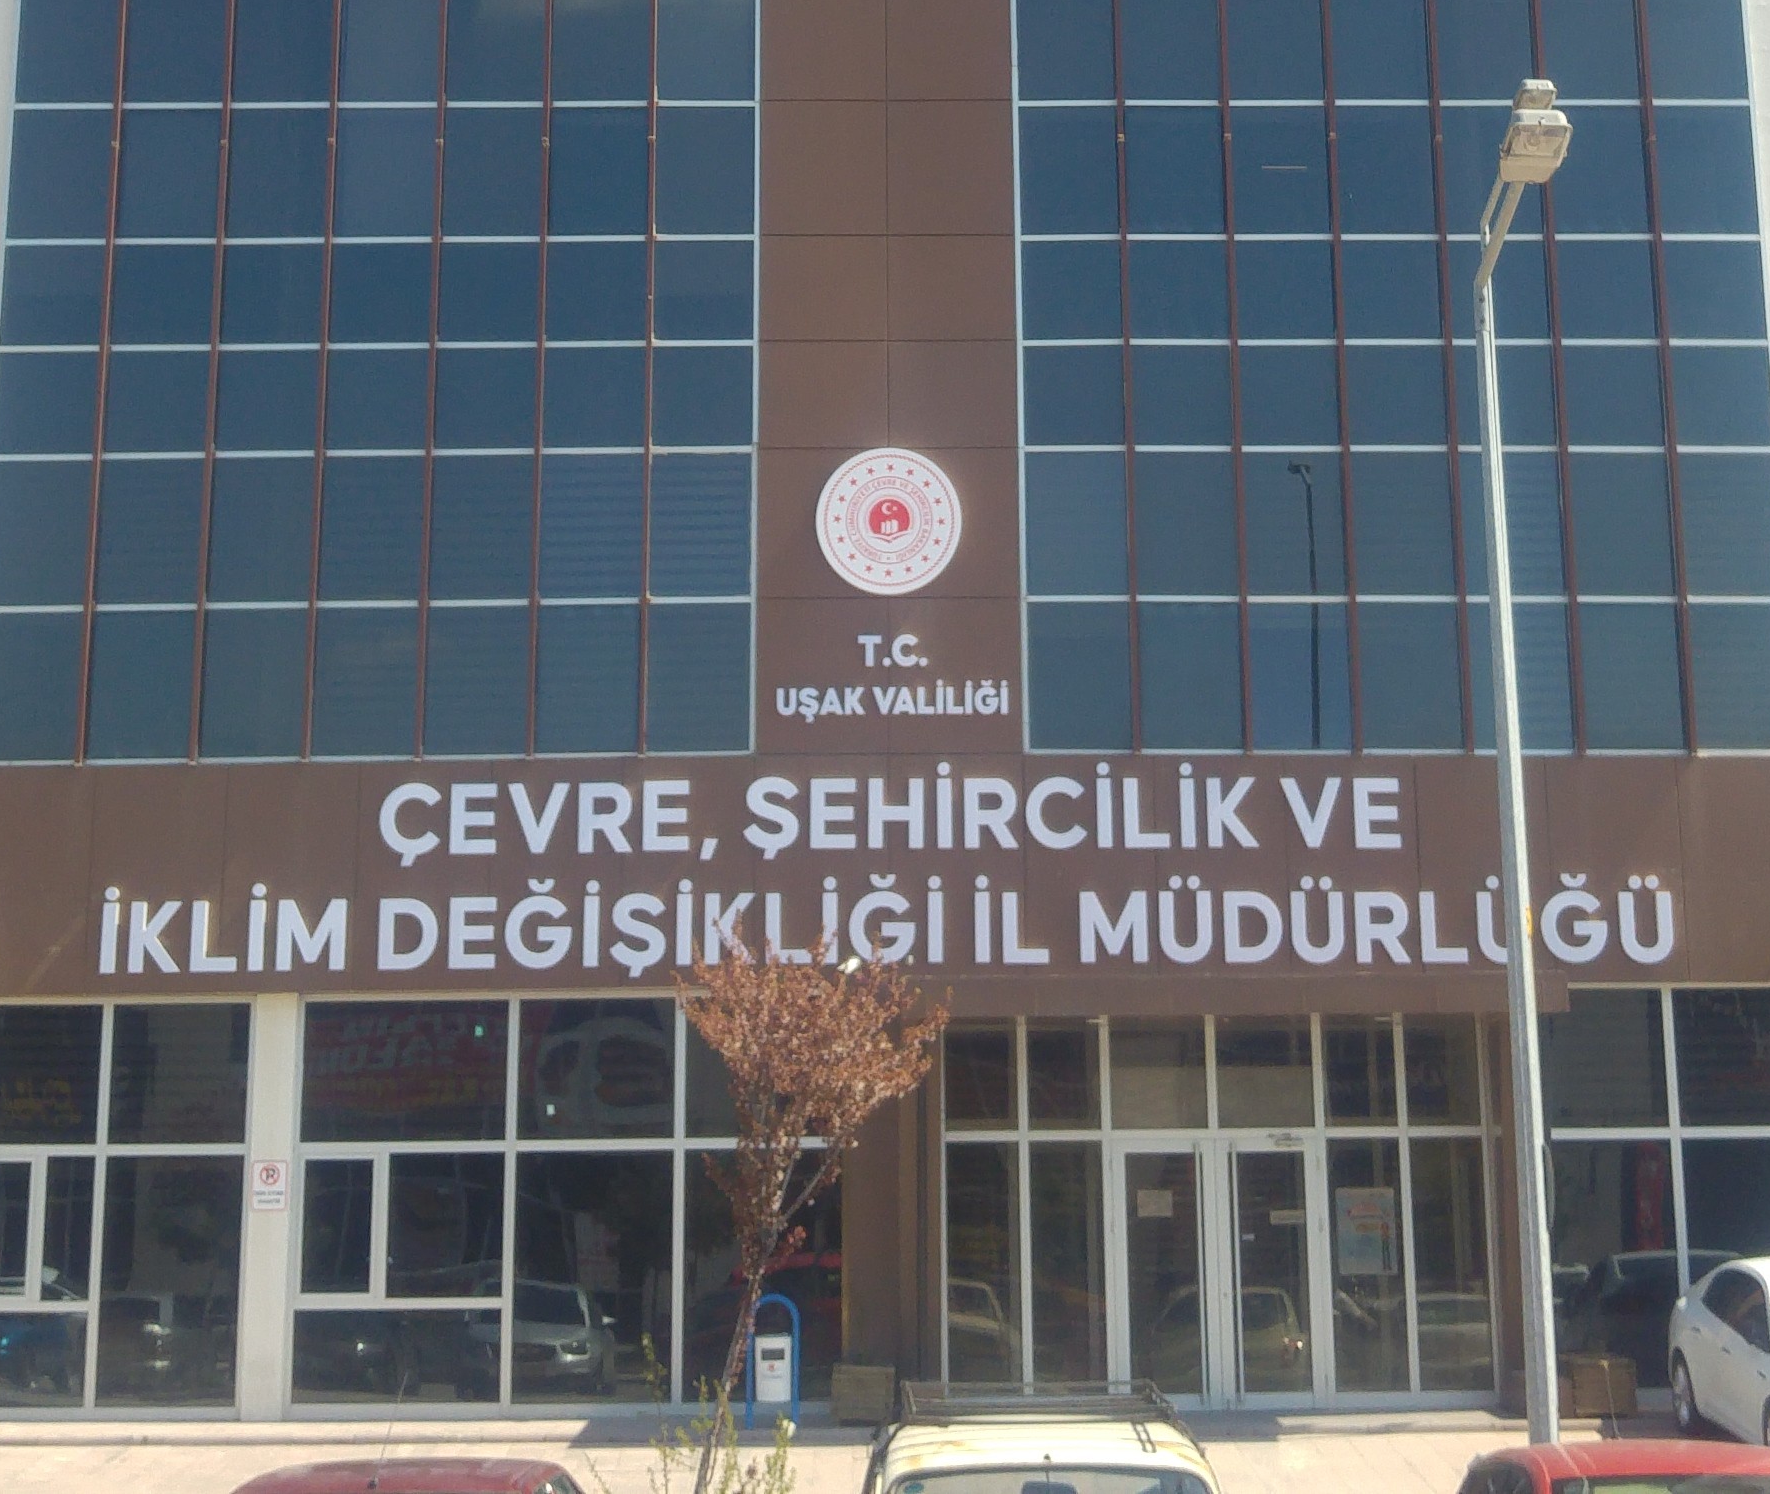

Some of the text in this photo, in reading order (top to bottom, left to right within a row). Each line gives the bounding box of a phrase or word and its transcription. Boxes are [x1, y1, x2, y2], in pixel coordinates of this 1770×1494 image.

[857, 633, 928, 667] T.C.
[776, 679, 1009, 723] UŞAK VALİLİĞİ
[379, 761, 1402, 867] ÇEVRE, ŞEHİRCİLİK VE
[99, 883, 348, 974] İKLİM
[377, 873, 944, 978] DEĞİŞİKLİĞİ
[974, 874, 1050, 964] İL
